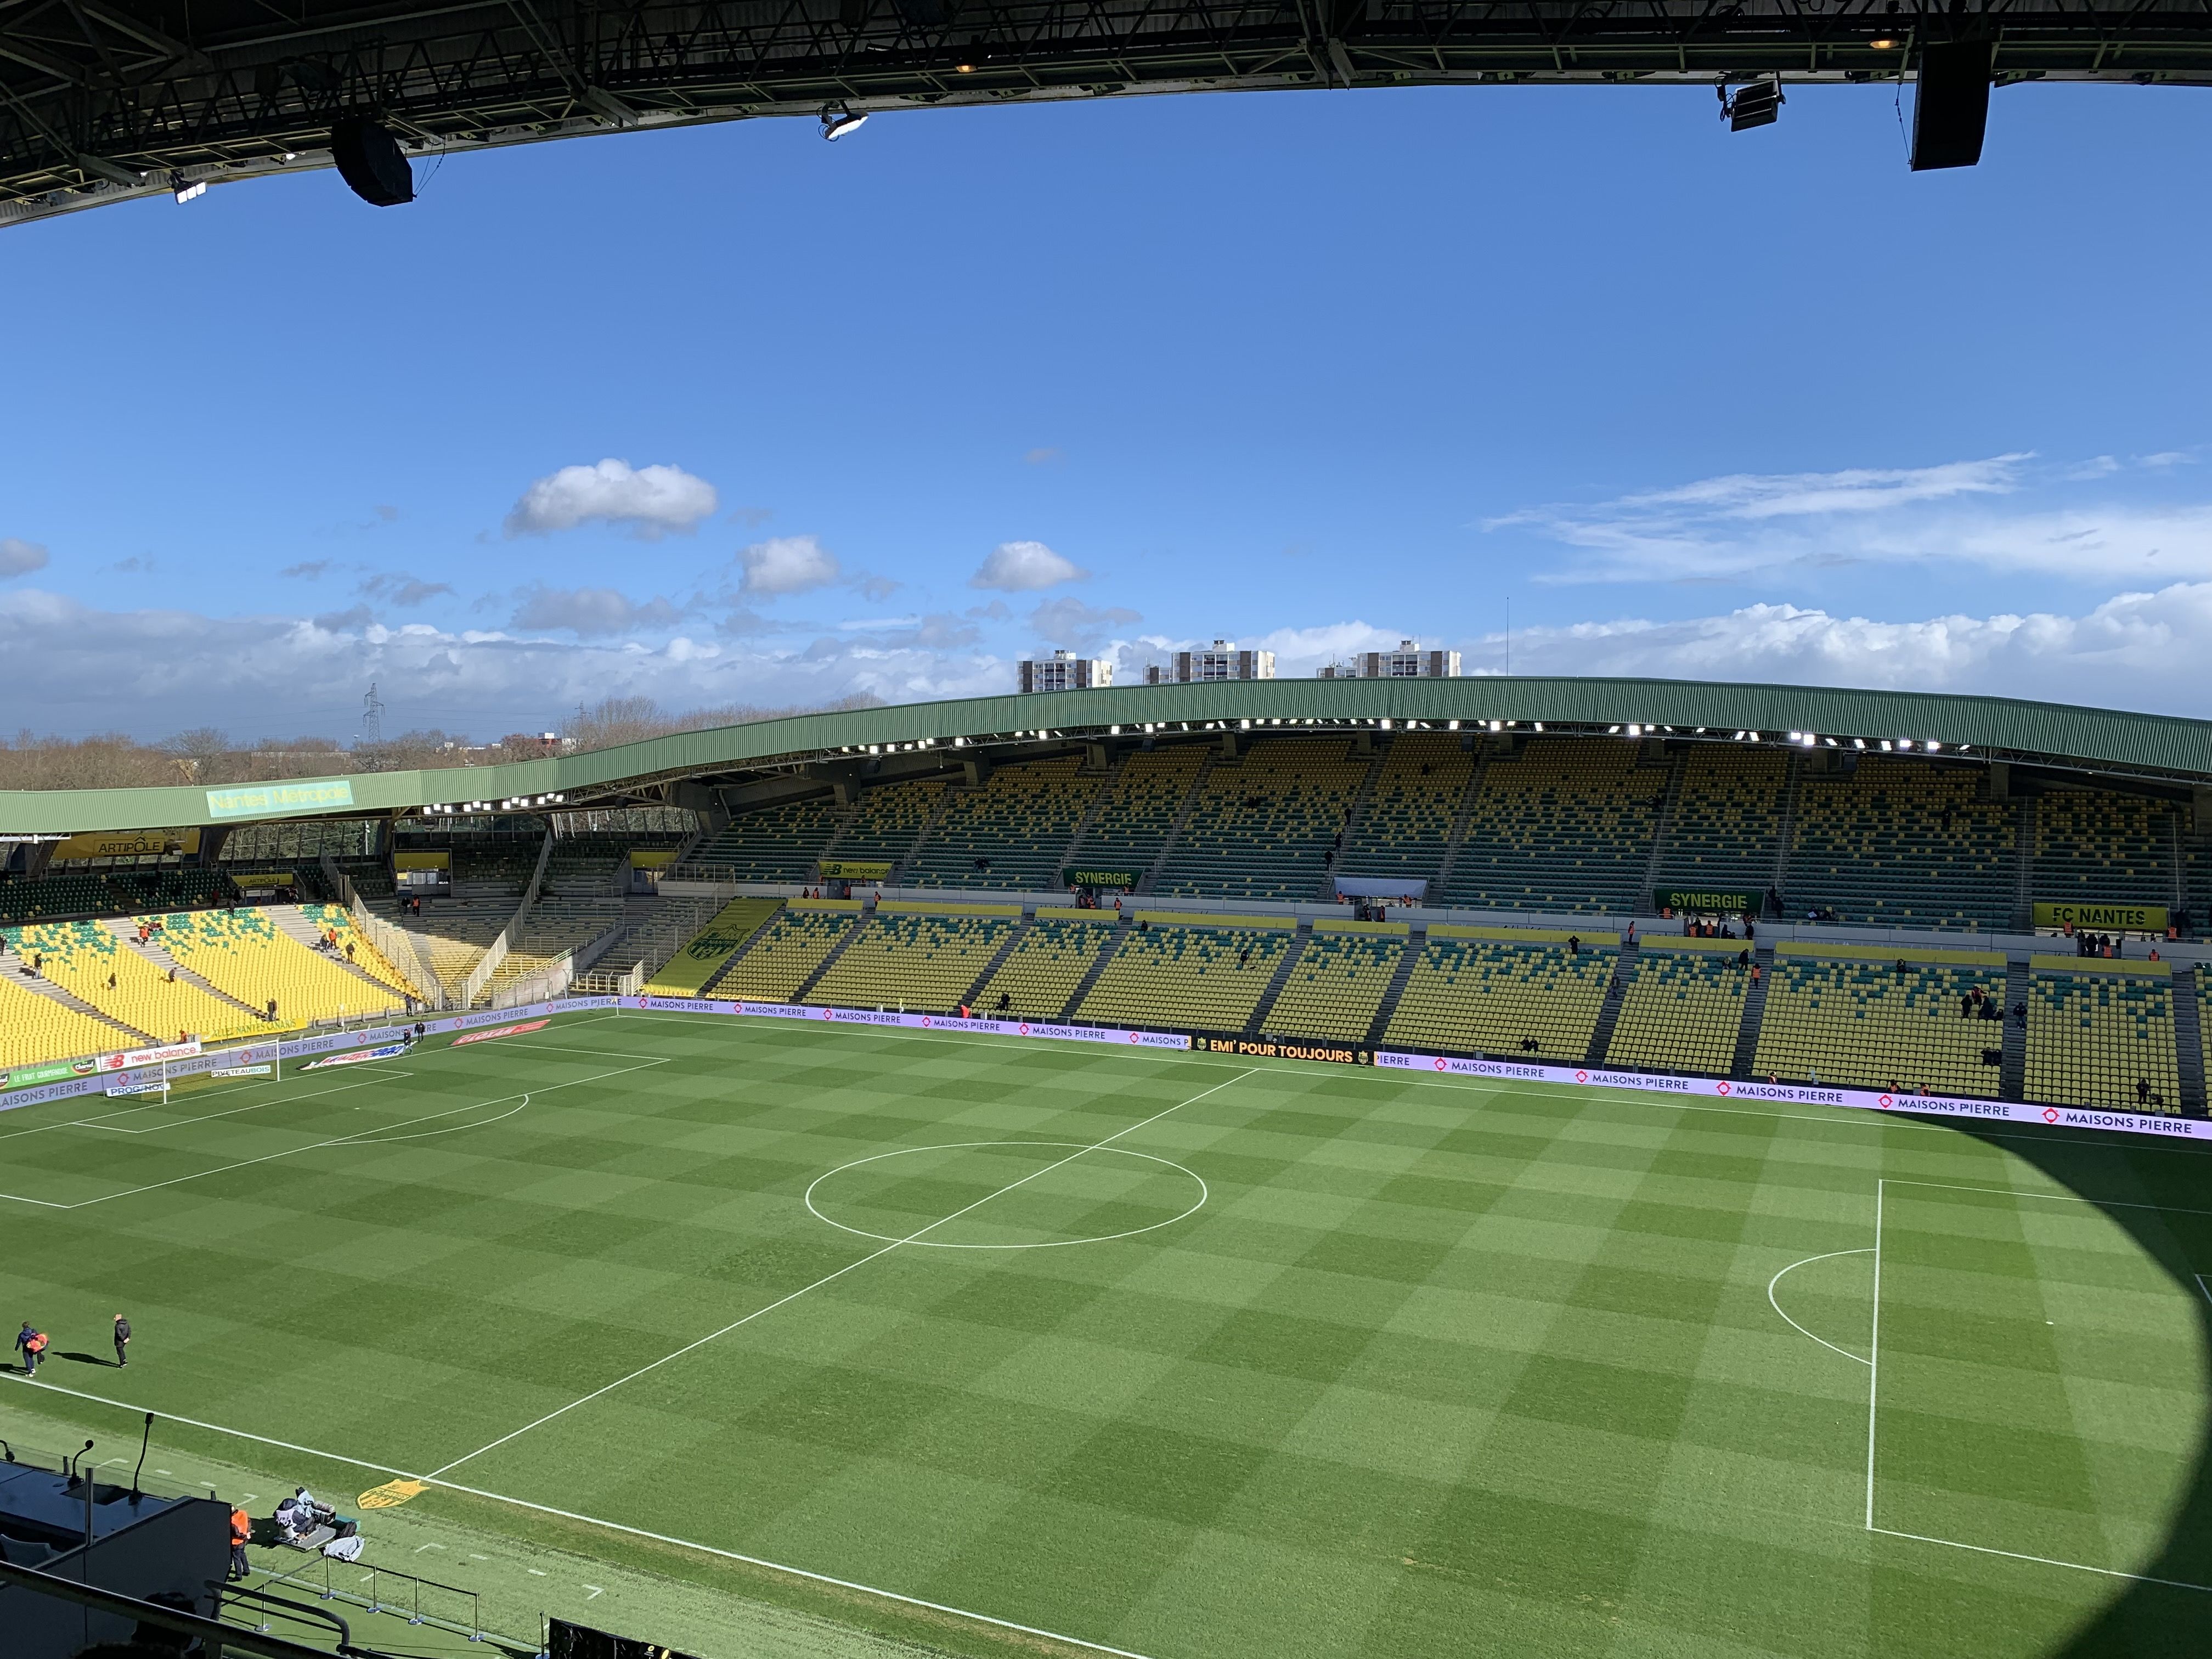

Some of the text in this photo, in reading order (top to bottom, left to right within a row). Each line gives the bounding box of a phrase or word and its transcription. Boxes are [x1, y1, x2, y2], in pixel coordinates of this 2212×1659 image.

[210, 794, 268, 810] Nantes
[1075, 871, 1132, 885] SYNERGIE
[1671, 893, 1747, 909] SYNERGIE
[2053, 907, 2145, 925] FC NANTES
[556, 1001, 589, 1010] MAISONS
[466, 1008, 528, 1025] MAISONS PIERRE
[836, 1012, 901, 1023] MAISONS PIERRE
[934, 1020, 968, 1028] MAISONS
[236, 1023, 265, 1034] NANTES
[267, 1019, 296, 1030] CANARIS
[1032, 1027, 1105, 1039] MAISONS PIERRE
[1143, 1036, 1181, 1045] MAISONS
[132, 1053, 151, 1063] new
[155, 1046, 196, 1059] balance
[256, 1040, 334, 1059] MAISONS PIERRE
[1239, 1041, 1276, 1056] POUR
[1278, 1046, 1353, 1063] TOUJOURS
[22, 1072, 36, 1081] FRUIT
[133, 1065, 177, 1081] MAISONS
[212, 1066, 270, 1076] PIVETEAUBOIS
[1451, 1062, 1544, 1077] MAISONS PIERRE
[1593, 1074, 1689, 1090] MAISONS PIERRE
[0, 1081, 88, 1107] AISONS PIERRE
[1736, 1086, 1843, 1102] MAISONS PIERRE
[1898, 1098, 2010, 1116] MAISONS PIERRE
[2066, 1113, 2192, 1133] MAISONS PIERRE
